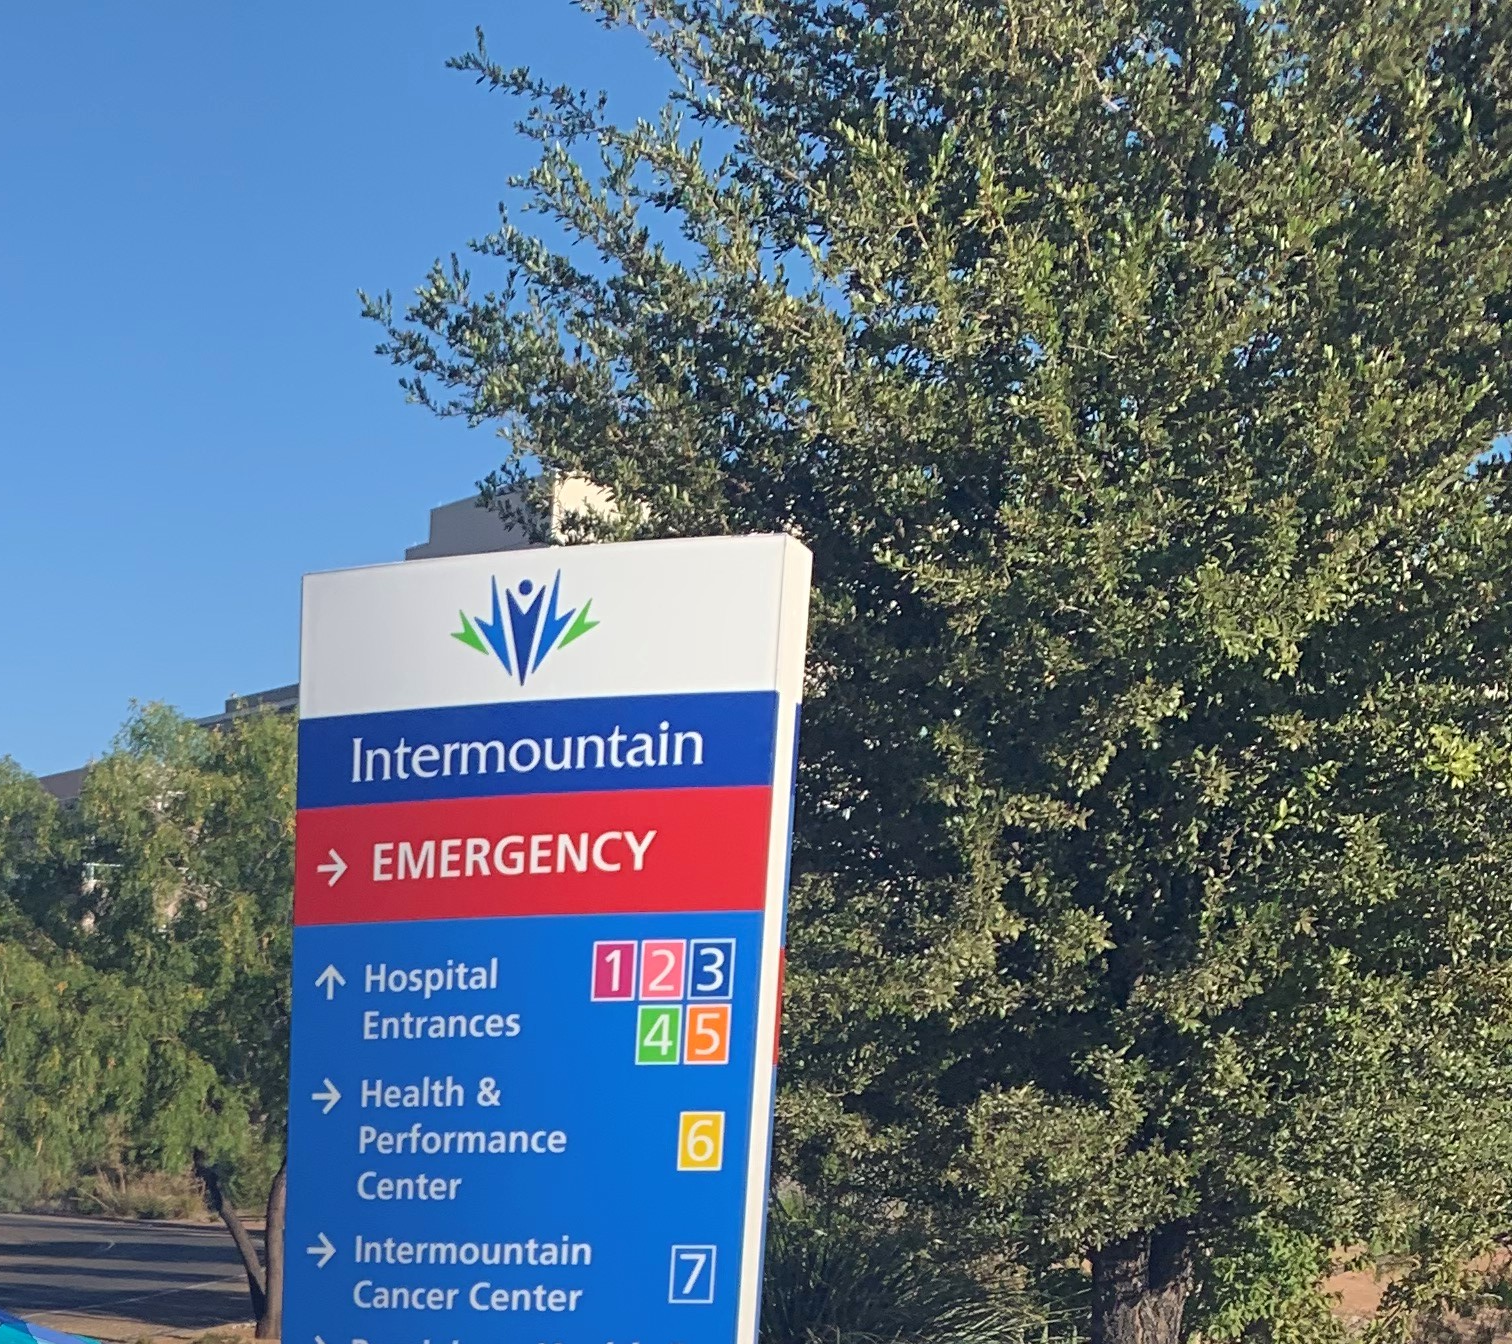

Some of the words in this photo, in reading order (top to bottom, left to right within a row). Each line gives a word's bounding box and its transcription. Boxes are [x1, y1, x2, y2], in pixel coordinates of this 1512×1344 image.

[352, 721, 704, 782] Intermountain
[373, 830, 657, 881] EMERGENCY
[364, 958, 498, 998] Hospital
[605, 949, 622, 992] 1
[651, 949, 676, 991] 2
[696, 947, 724, 990] 3
[363, 1011, 521, 1040] Entrances
[642, 1013, 674, 1056] 4
[694, 1013, 721, 1056] 5
[361, 1076, 465, 1108] Health
[477, 1076, 501, 1107] &
[358, 1123, 567, 1154] Performance
[686, 1119, 715, 1163] 6
[356, 1171, 462, 1200] Center
[355, 1235, 592, 1266] Intermountain
[678, 1253, 707, 1295] 7
[352, 1281, 459, 1310] Cancer
[469, 1282, 583, 1312] Center
